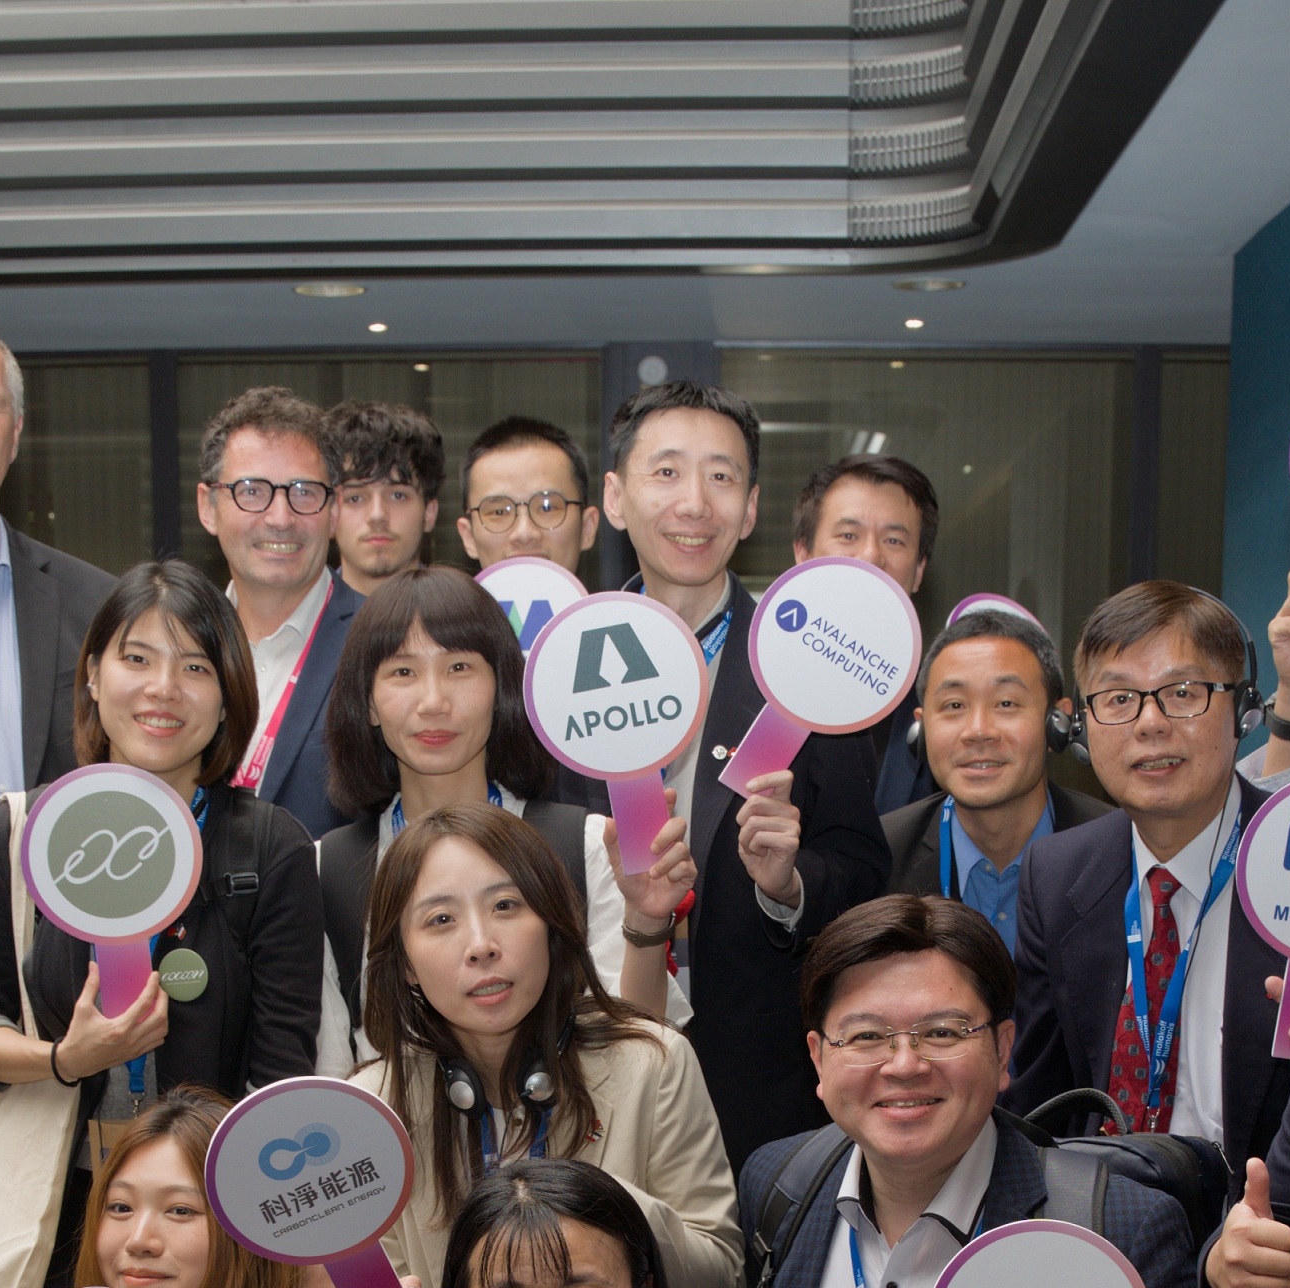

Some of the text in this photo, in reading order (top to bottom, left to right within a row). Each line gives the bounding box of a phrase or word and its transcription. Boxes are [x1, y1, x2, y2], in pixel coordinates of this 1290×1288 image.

[802, 632, 889, 696] COMPUTING
[810, 616, 899, 680] AVALANCHE
[565, 694, 682, 741] APOLLO
[1155, 1020, 1168, 1057] malakoff
[1162, 1022, 1175, 1058] humanis
[258, 1156, 380, 1225] 科淨能源
[272, 1185, 386, 1238] CARBONCLEAN ENERGY
